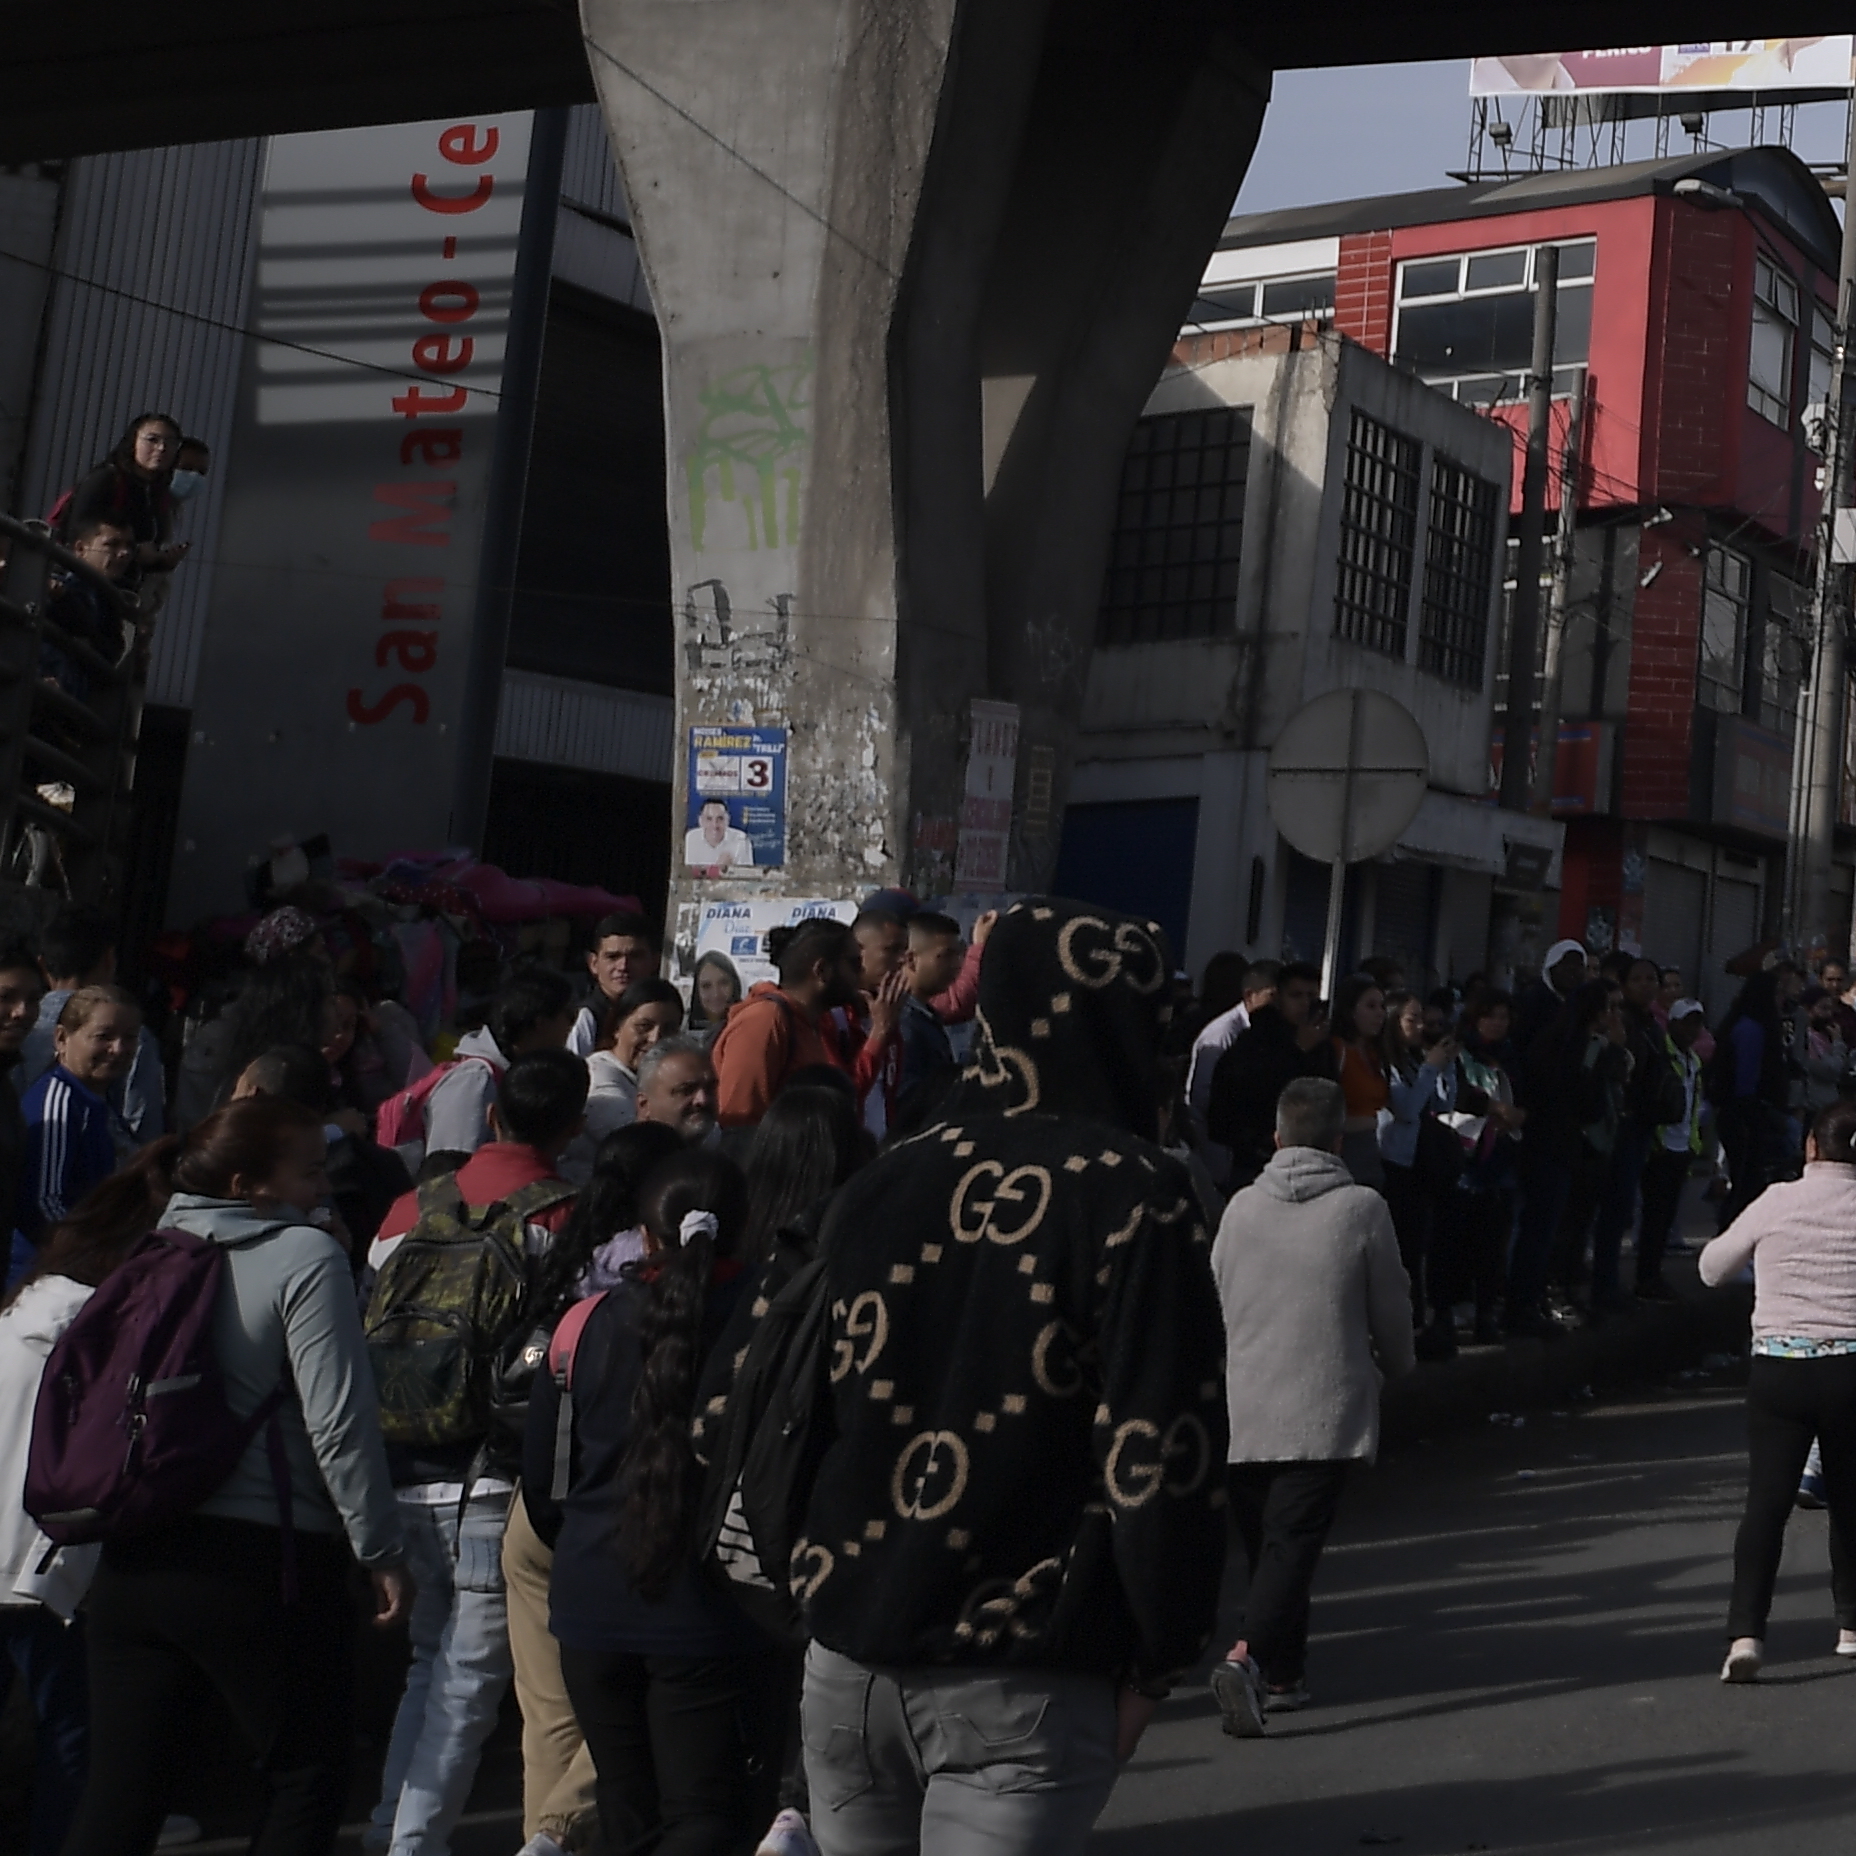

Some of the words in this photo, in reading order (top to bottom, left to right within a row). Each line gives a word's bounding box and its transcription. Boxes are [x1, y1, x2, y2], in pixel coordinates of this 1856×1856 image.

[368, 278, 482, 549] Mateo
[345, 576, 447, 727] San
[746, 759, 769, 788] 3
[706, 907, 752, 919] DIANA
[791, 906, 837, 919] DIANA
